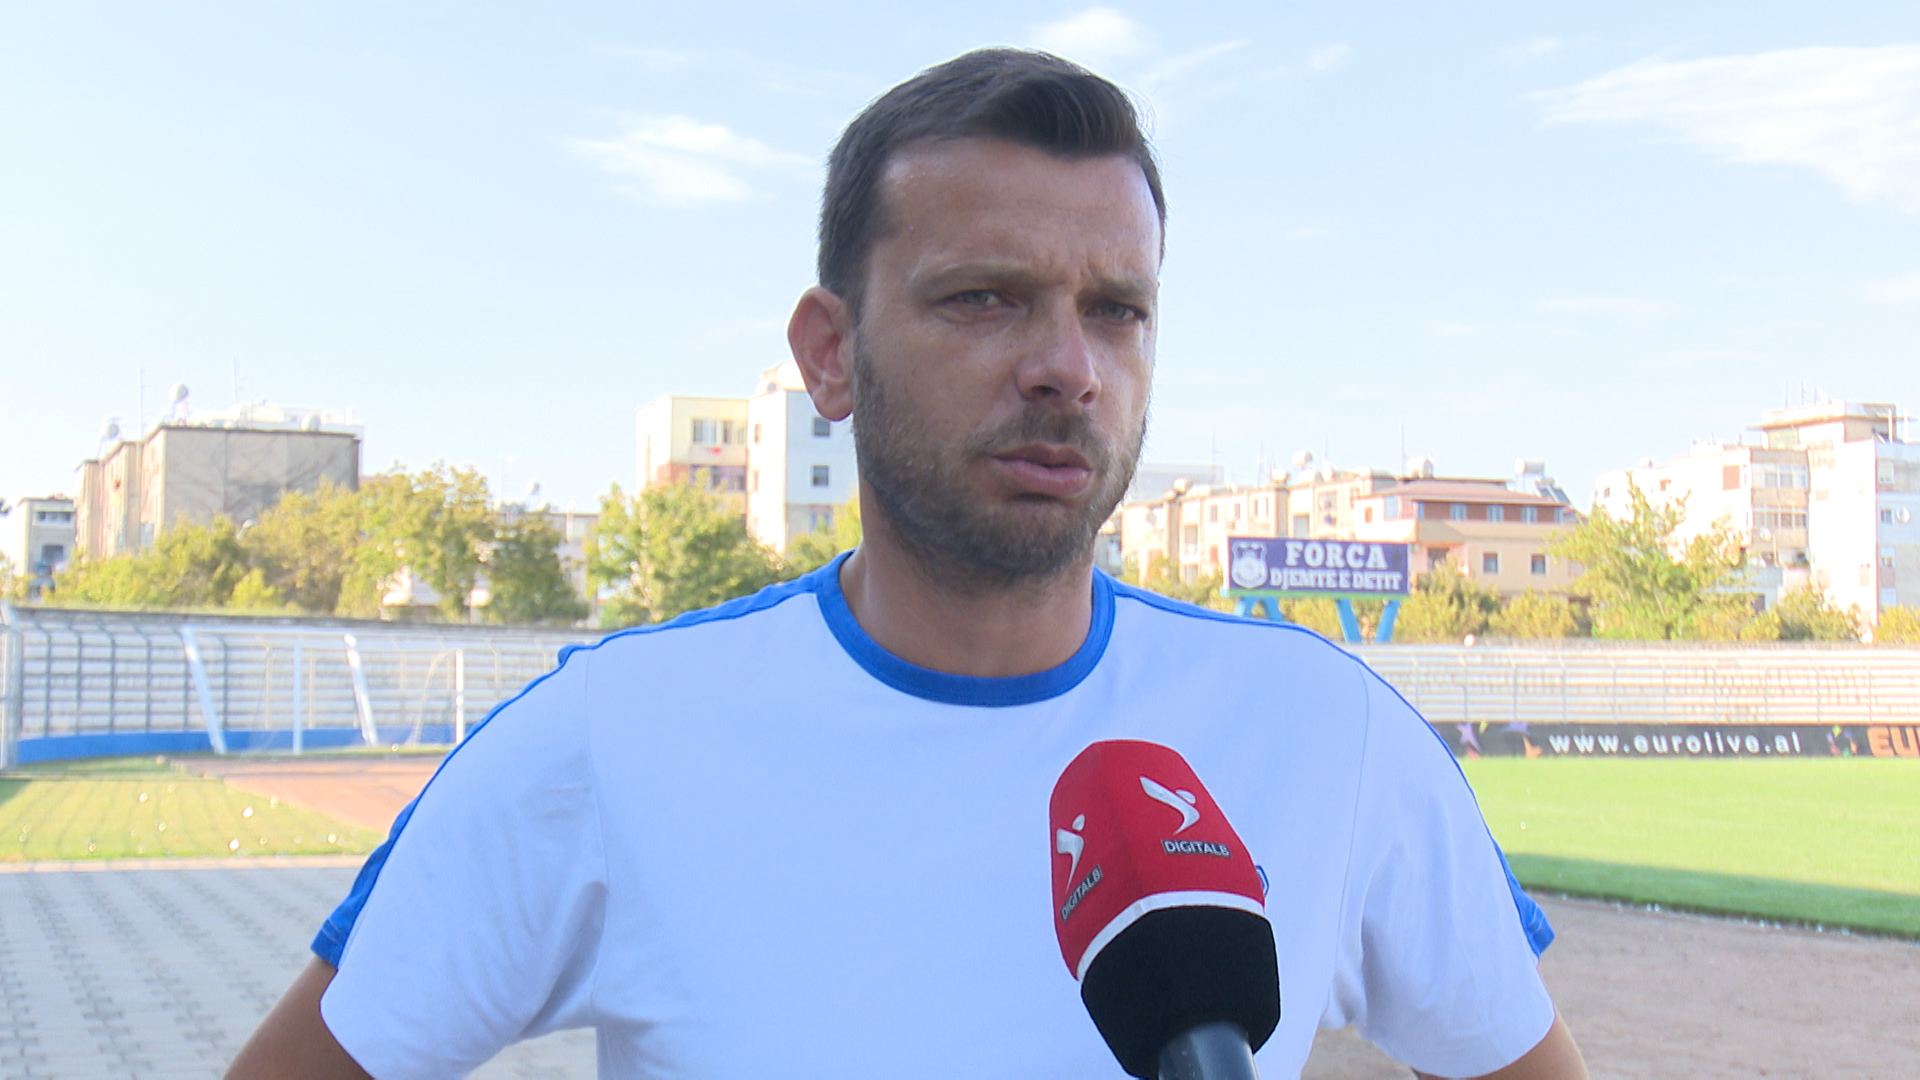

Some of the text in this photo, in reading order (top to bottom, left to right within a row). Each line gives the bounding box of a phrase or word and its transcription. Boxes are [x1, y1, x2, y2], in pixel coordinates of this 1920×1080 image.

[1285, 541, 1387, 569] FORCA
[1549, 731, 1801, 754] www.eurolive.al
[1867, 727, 1920, 757] EU
[1164, 840, 1230, 856] DIGITALB
